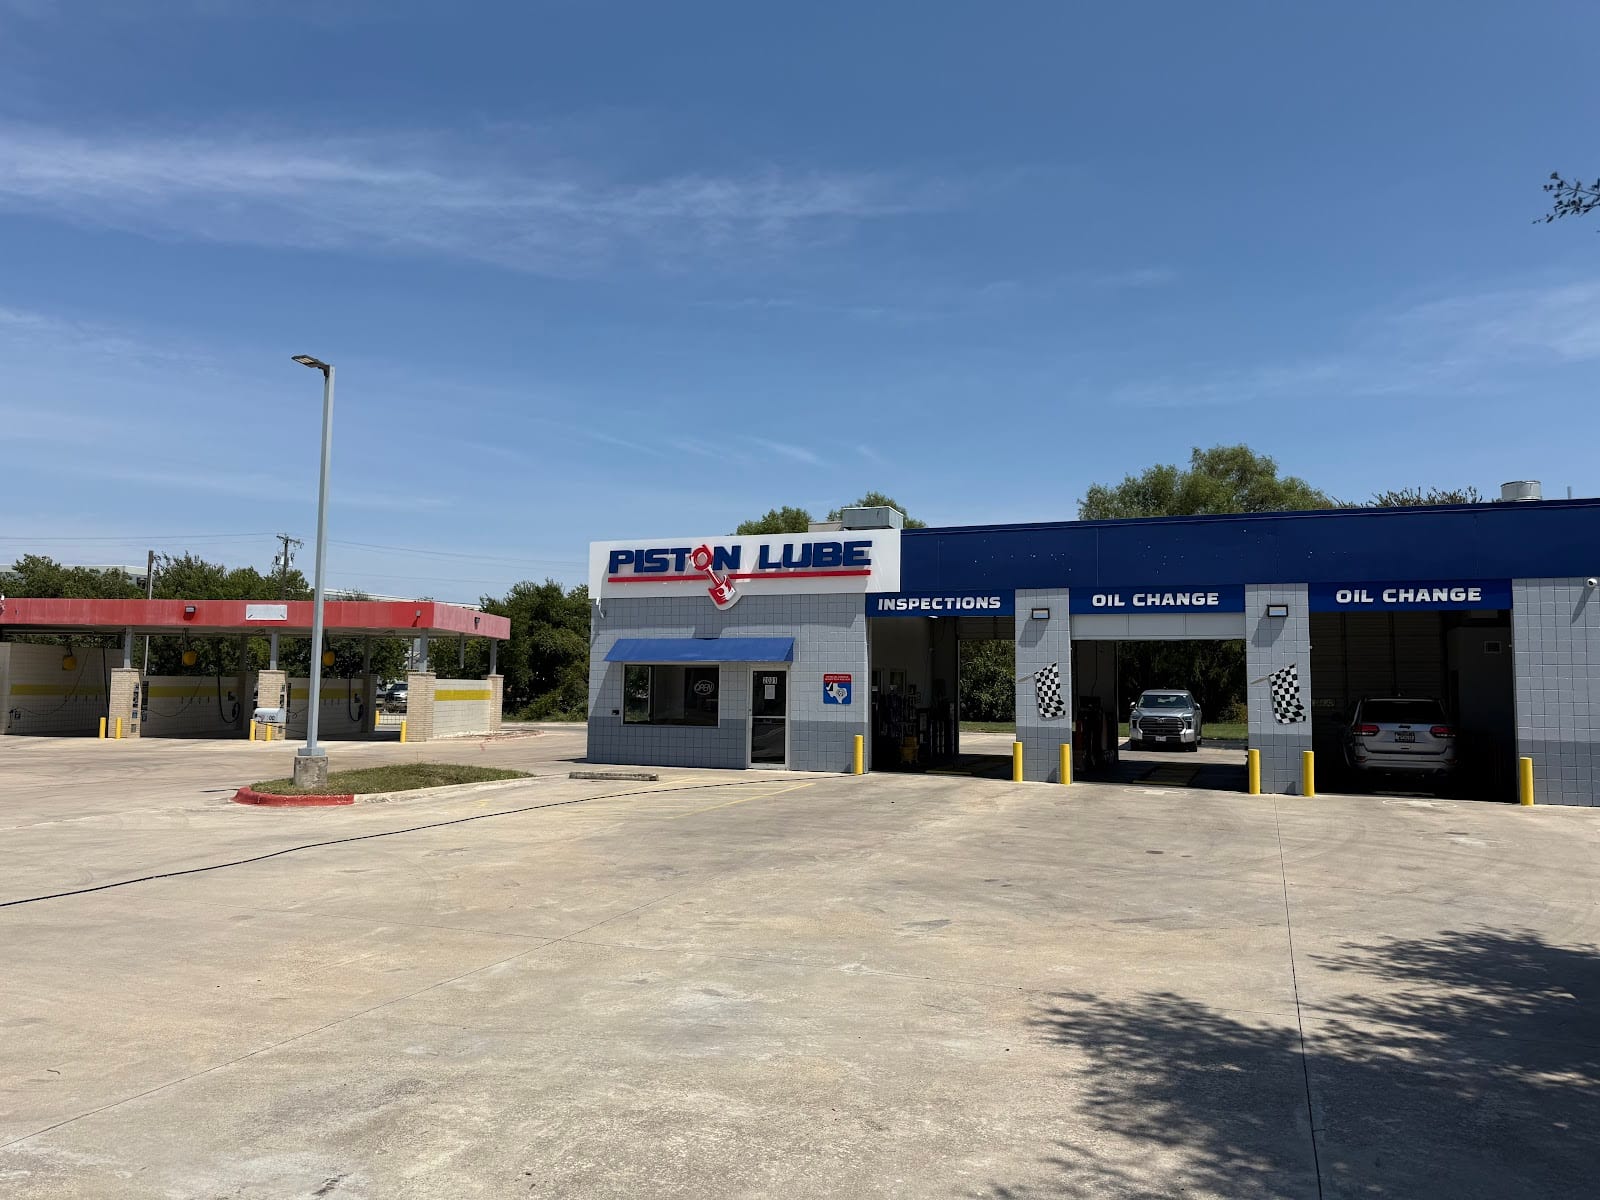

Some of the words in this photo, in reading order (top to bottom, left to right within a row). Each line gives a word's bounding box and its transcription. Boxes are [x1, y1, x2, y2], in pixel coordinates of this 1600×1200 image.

[608, 544, 742, 574] PISTON
[758, 540, 873, 570] LUBE
[1092, 594, 1125, 607] OIL
[1132, 592, 1219, 607] CHANGE
[1335, 589, 1374, 604] OIL
[1382, 587, 1482, 603] CHANGE
[878, 597, 1001, 611] INSPECTIONS
